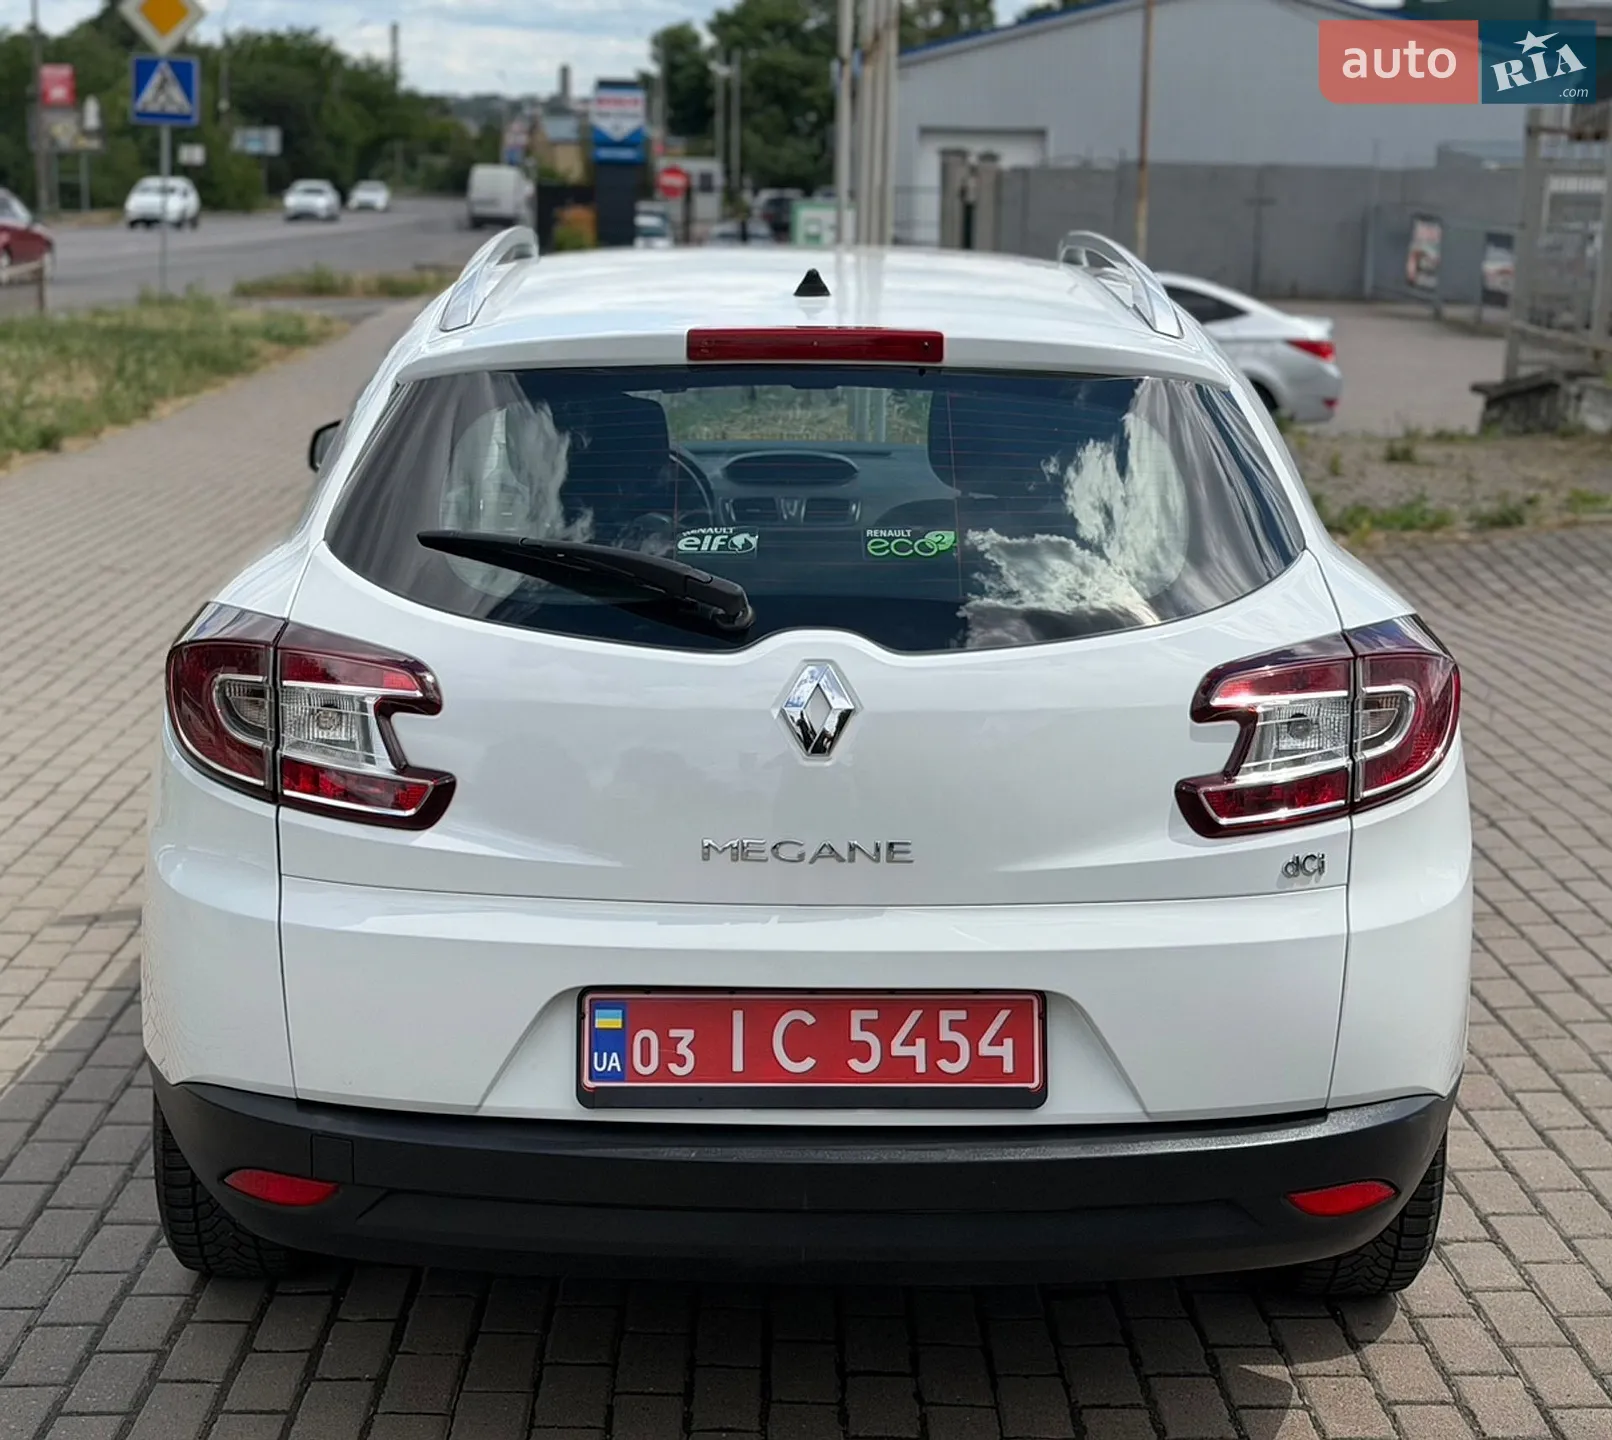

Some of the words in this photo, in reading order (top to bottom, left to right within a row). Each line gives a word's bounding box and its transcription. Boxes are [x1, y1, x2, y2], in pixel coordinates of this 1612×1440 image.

[677, 535, 728, 551] elf
[866, 529, 912, 537] RENAULT
[702, 838, 914, 864] MEGANE
[1282, 852, 1325, 878] dCi
[632, 1029, 695, 1076] 03
[847, 1009, 1014, 1074] 5454
[593, 1052, 621, 1072] UA
